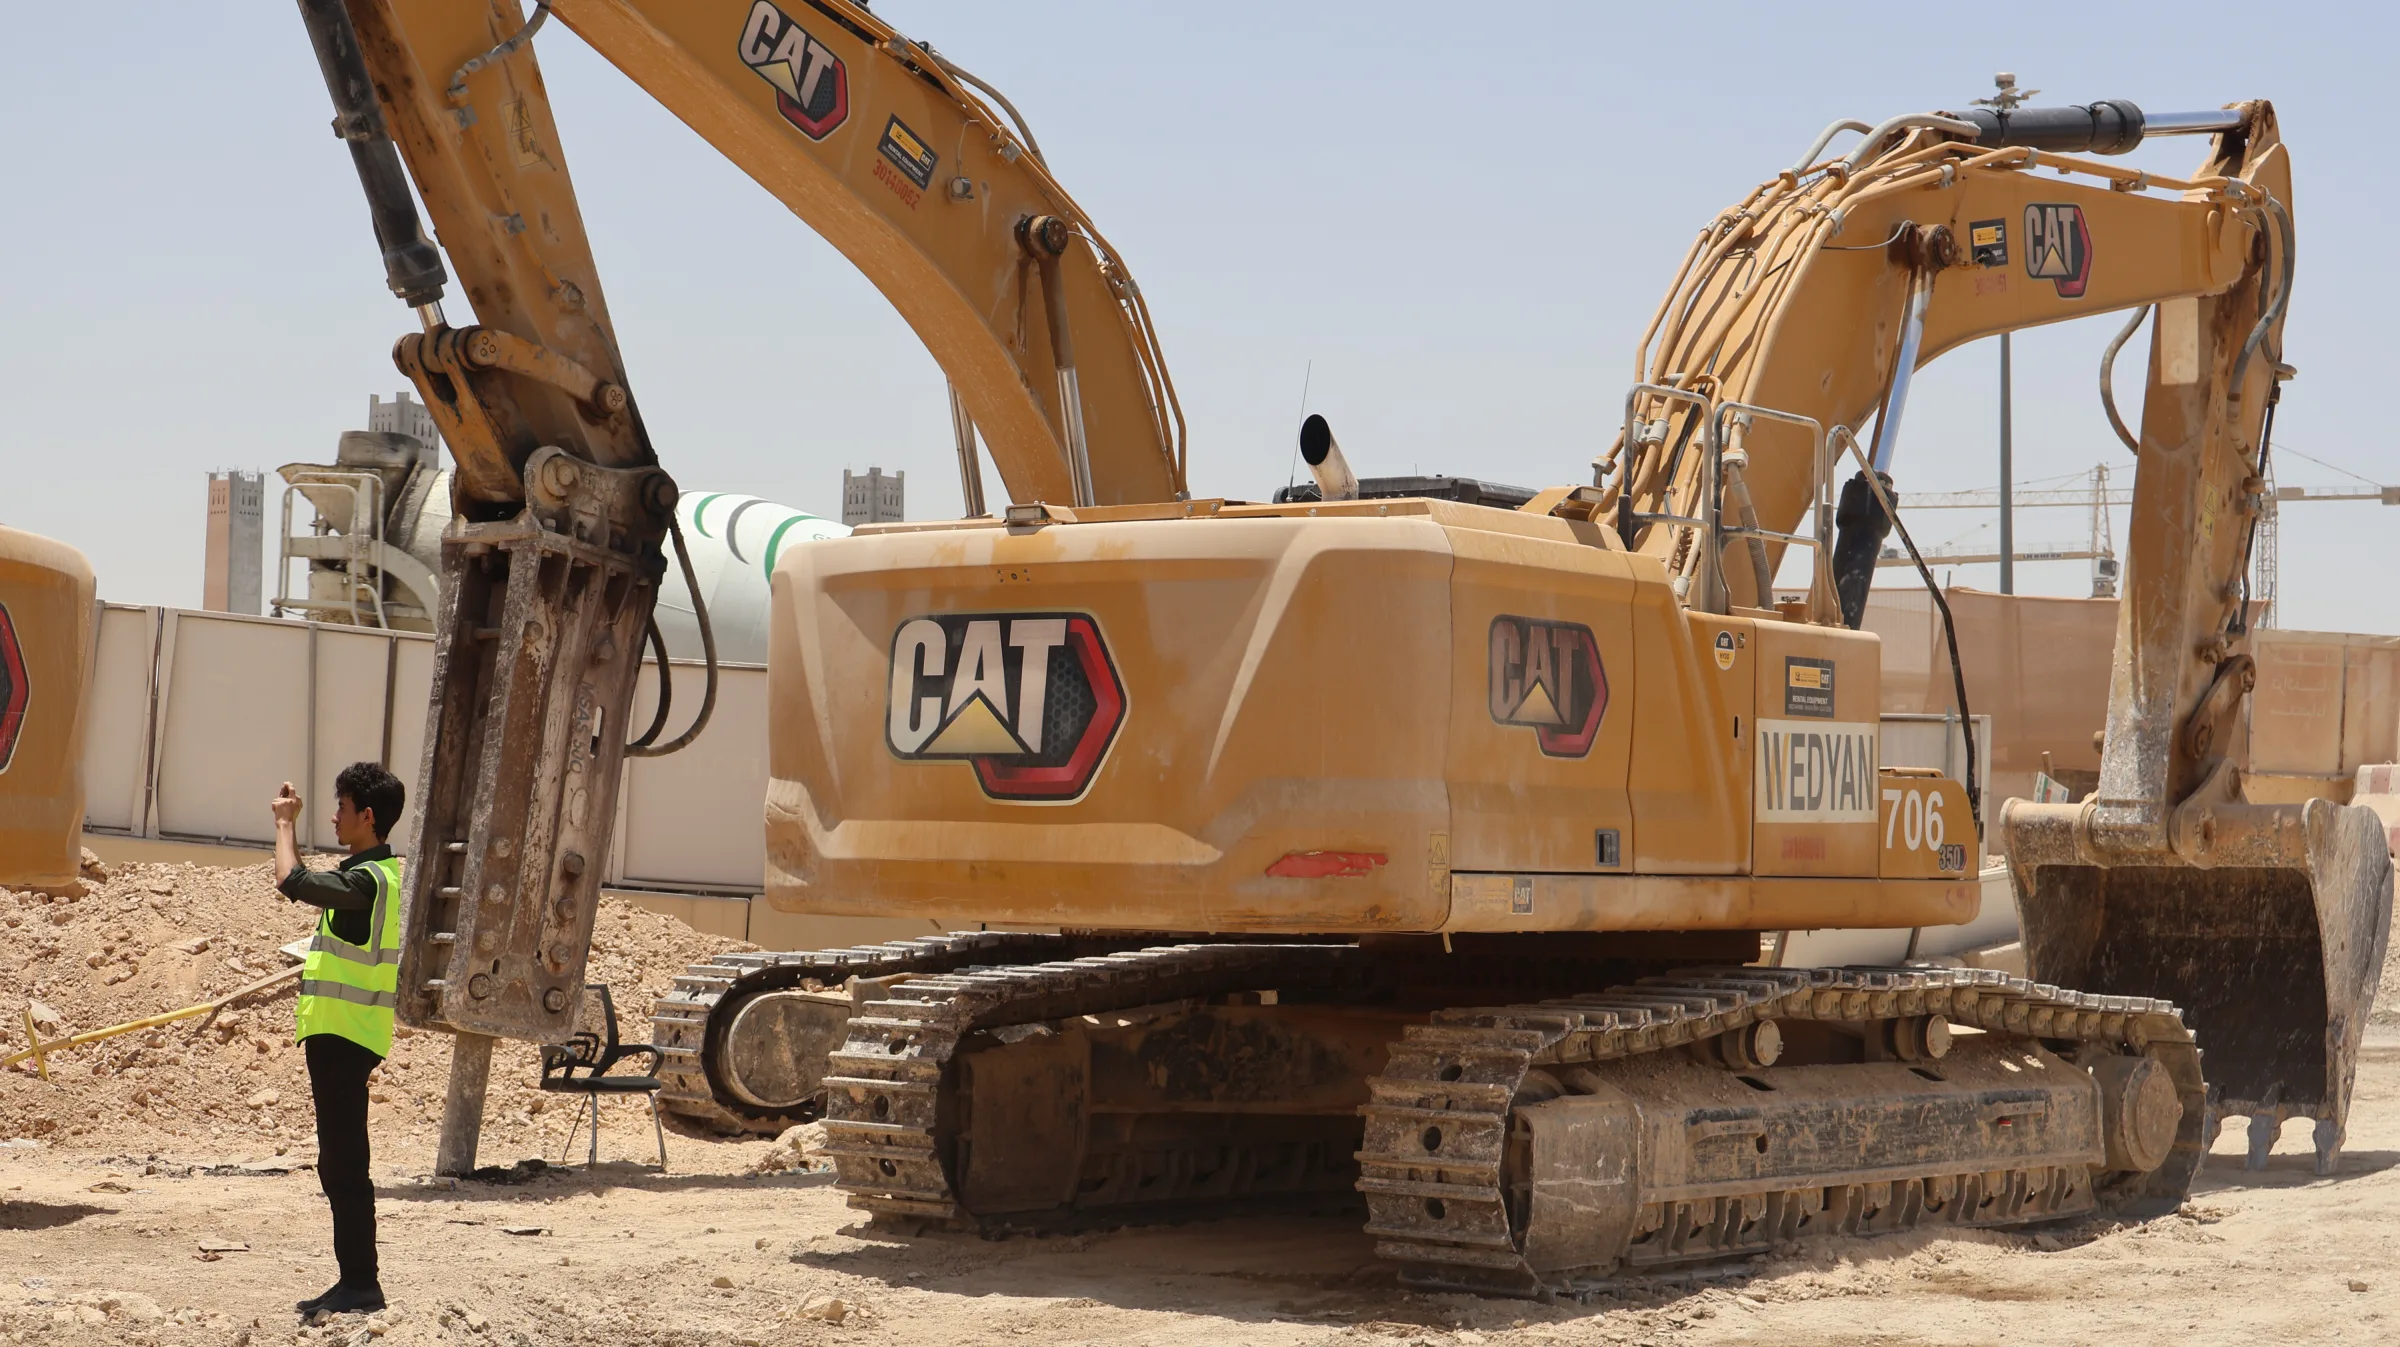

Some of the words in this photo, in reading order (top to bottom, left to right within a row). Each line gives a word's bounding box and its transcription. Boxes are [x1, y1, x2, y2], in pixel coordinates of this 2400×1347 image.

[740, 1, 835, 109] CAT
[887, 143, 903, 159] RENTAL
[901, 155, 924, 178] EQUIPMENT
[920, 153, 931, 166] CAT
[2025, 205, 2075, 276] CAT
[890, 618, 1067, 754] CAT
[1490, 620, 1579, 725] CAT
[1821, 673, 1830, 684] CAT
[1792, 695, 1807, 704] RENTAL
[1806, 696, 1828, 705] EQUIPMENT
[1762, 731, 1874, 811] WEDYAN
[1882, 789, 1944, 851] 706
[1939, 844, 1961, 871] 350
[1514, 887, 1531, 905] CAT
